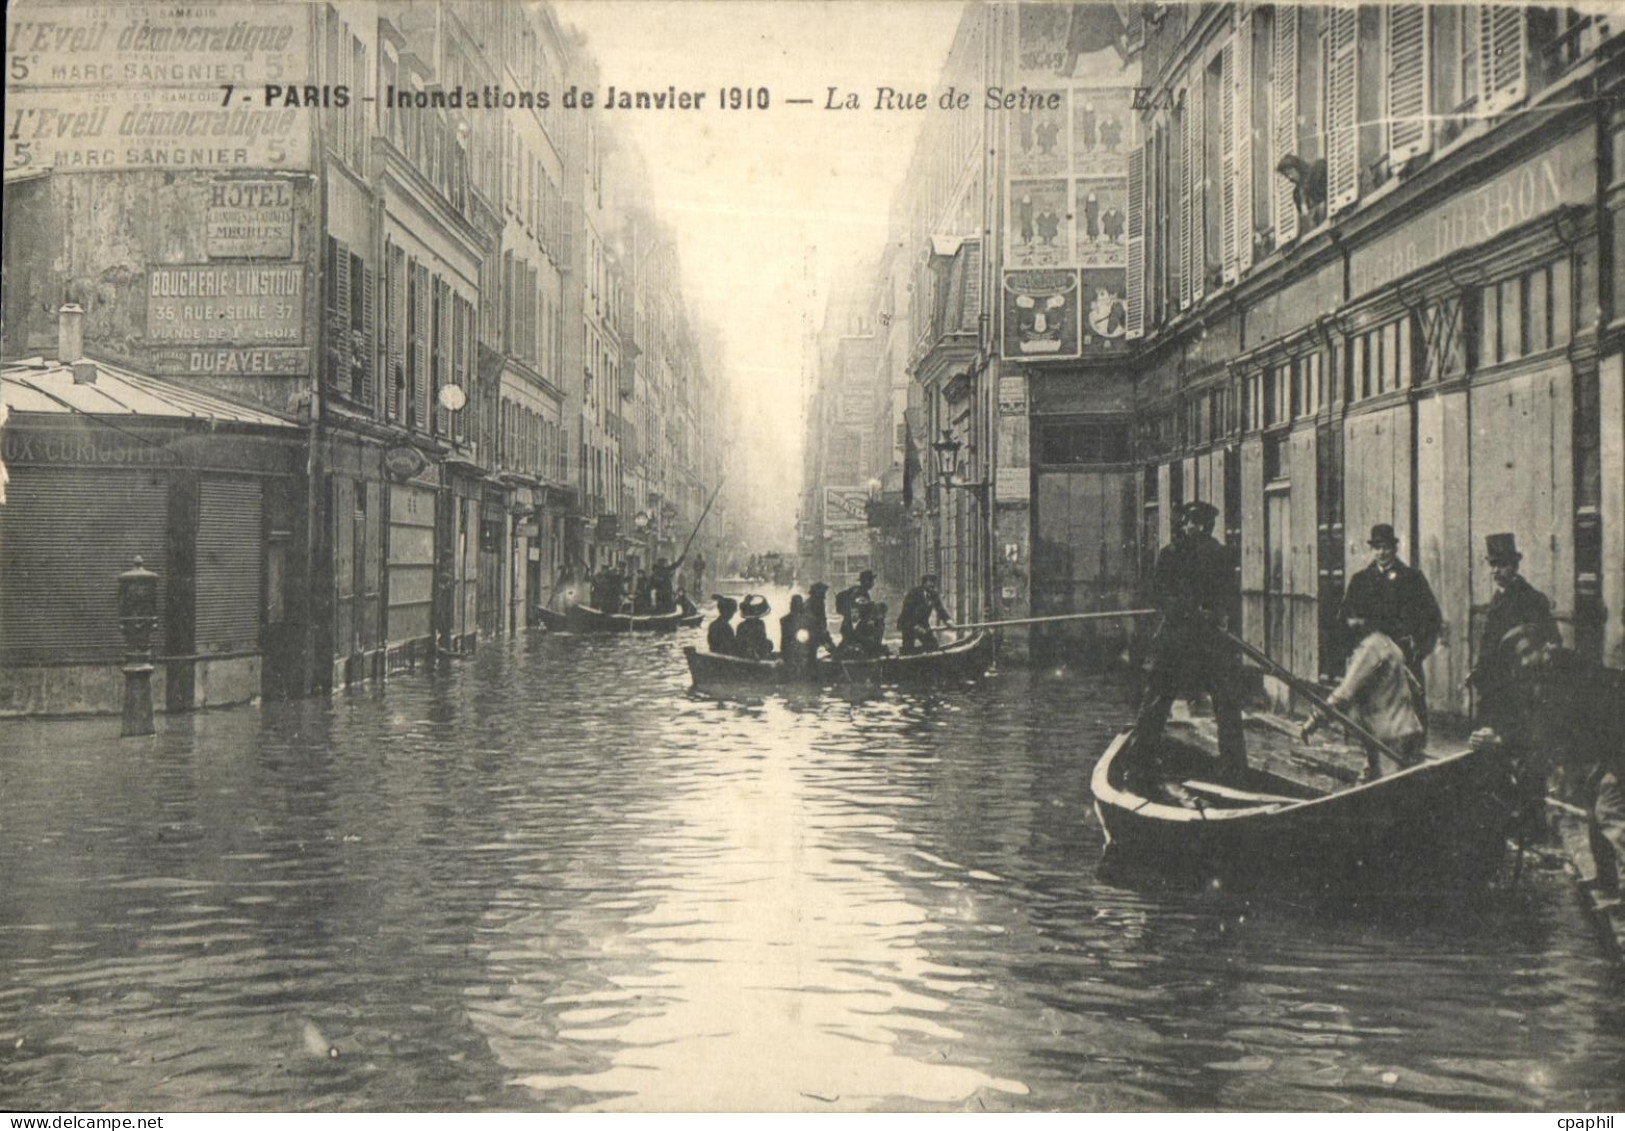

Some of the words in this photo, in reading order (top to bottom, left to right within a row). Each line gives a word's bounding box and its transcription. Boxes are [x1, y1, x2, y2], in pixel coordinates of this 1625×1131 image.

[117, 20, 293, 61] démocratique
[51, 64, 113, 80] MARC
[124, 63, 246, 80] SANGNIER
[118, 103, 297, 146] démocratique
[54, 149, 115, 167] MARC
[126, 148, 248, 164] SANGNIER
[212, 184, 289, 207] HOTEL
[152, 271, 228, 296] BOUCHERIE
[156, 306, 175, 320] 35
[184, 306, 213, 320] RUE
[226, 305, 267, 320] SEINE
[152, 328, 200, 339] VIANDE
[208, 328, 226, 339] DE
[255, 328, 298, 339] CHOIX
[190, 352, 274, 371] DUFAYEL
